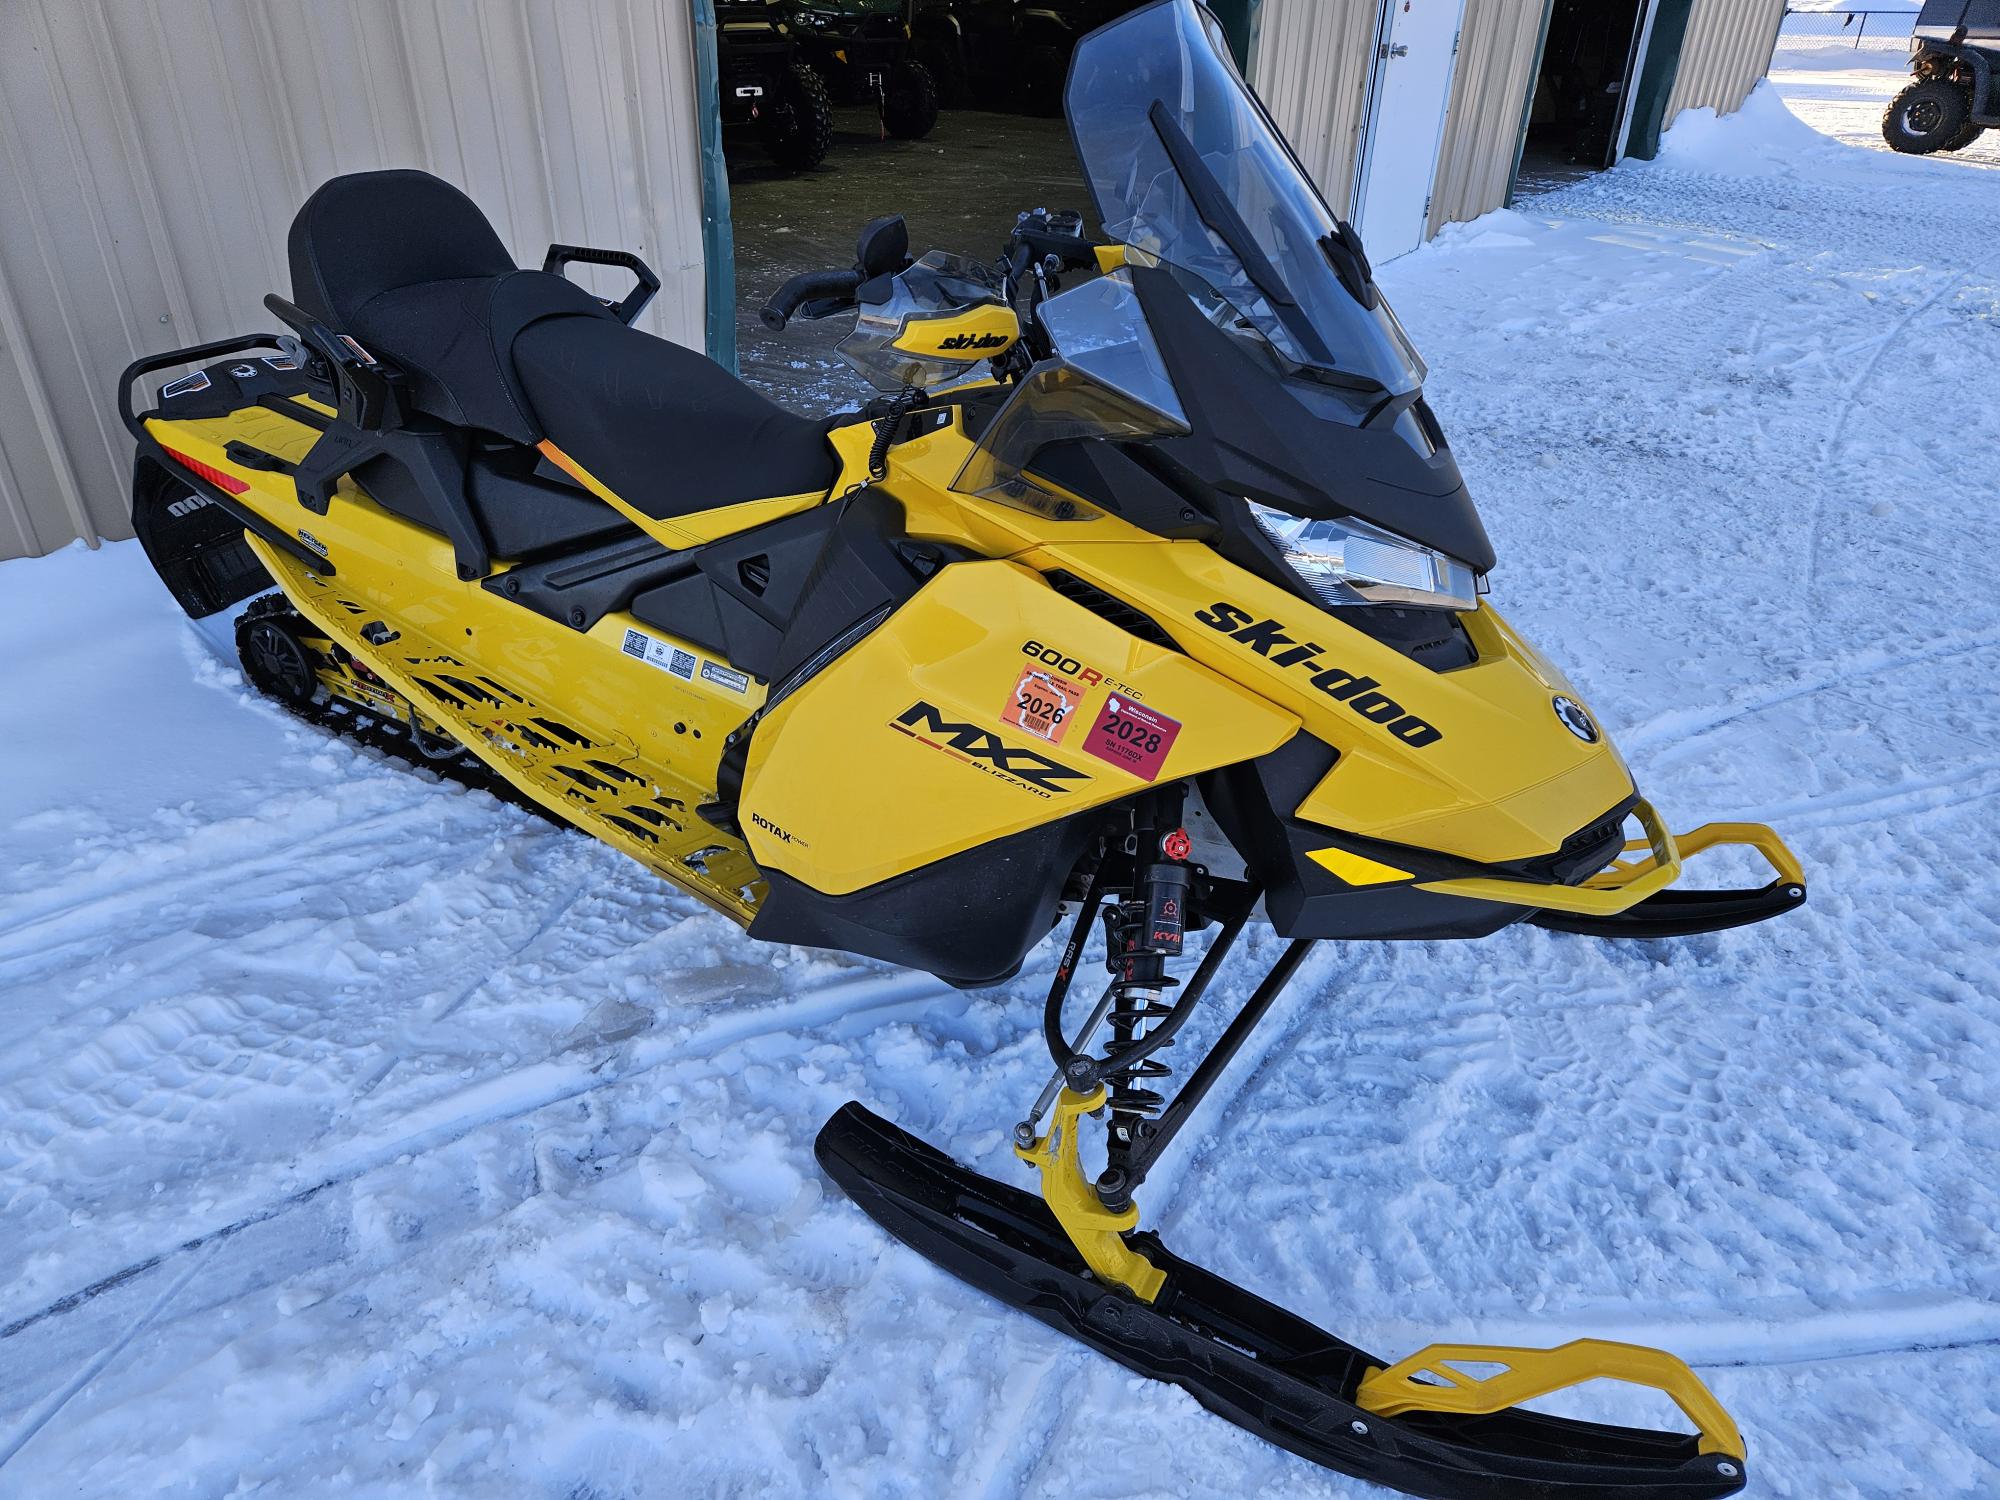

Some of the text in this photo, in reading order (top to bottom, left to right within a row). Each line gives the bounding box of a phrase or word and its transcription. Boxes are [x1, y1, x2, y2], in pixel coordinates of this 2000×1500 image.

[937, 333, 1009, 350] ski-doo
[1104, 677, 1143, 700] E-TEC
[1194, 602, 1443, 748] ski-doo
[1017, 693, 1065, 724] 2026
[1128, 705, 1158, 724] Wisconsin
[896, 701, 1093, 793] MXZ
[1102, 714, 1161, 754] 2028
[1105, 739, 1116, 749] SN
[970, 761, 1052, 799] BLIZZARD
[752, 812, 791, 844] ROTAX
